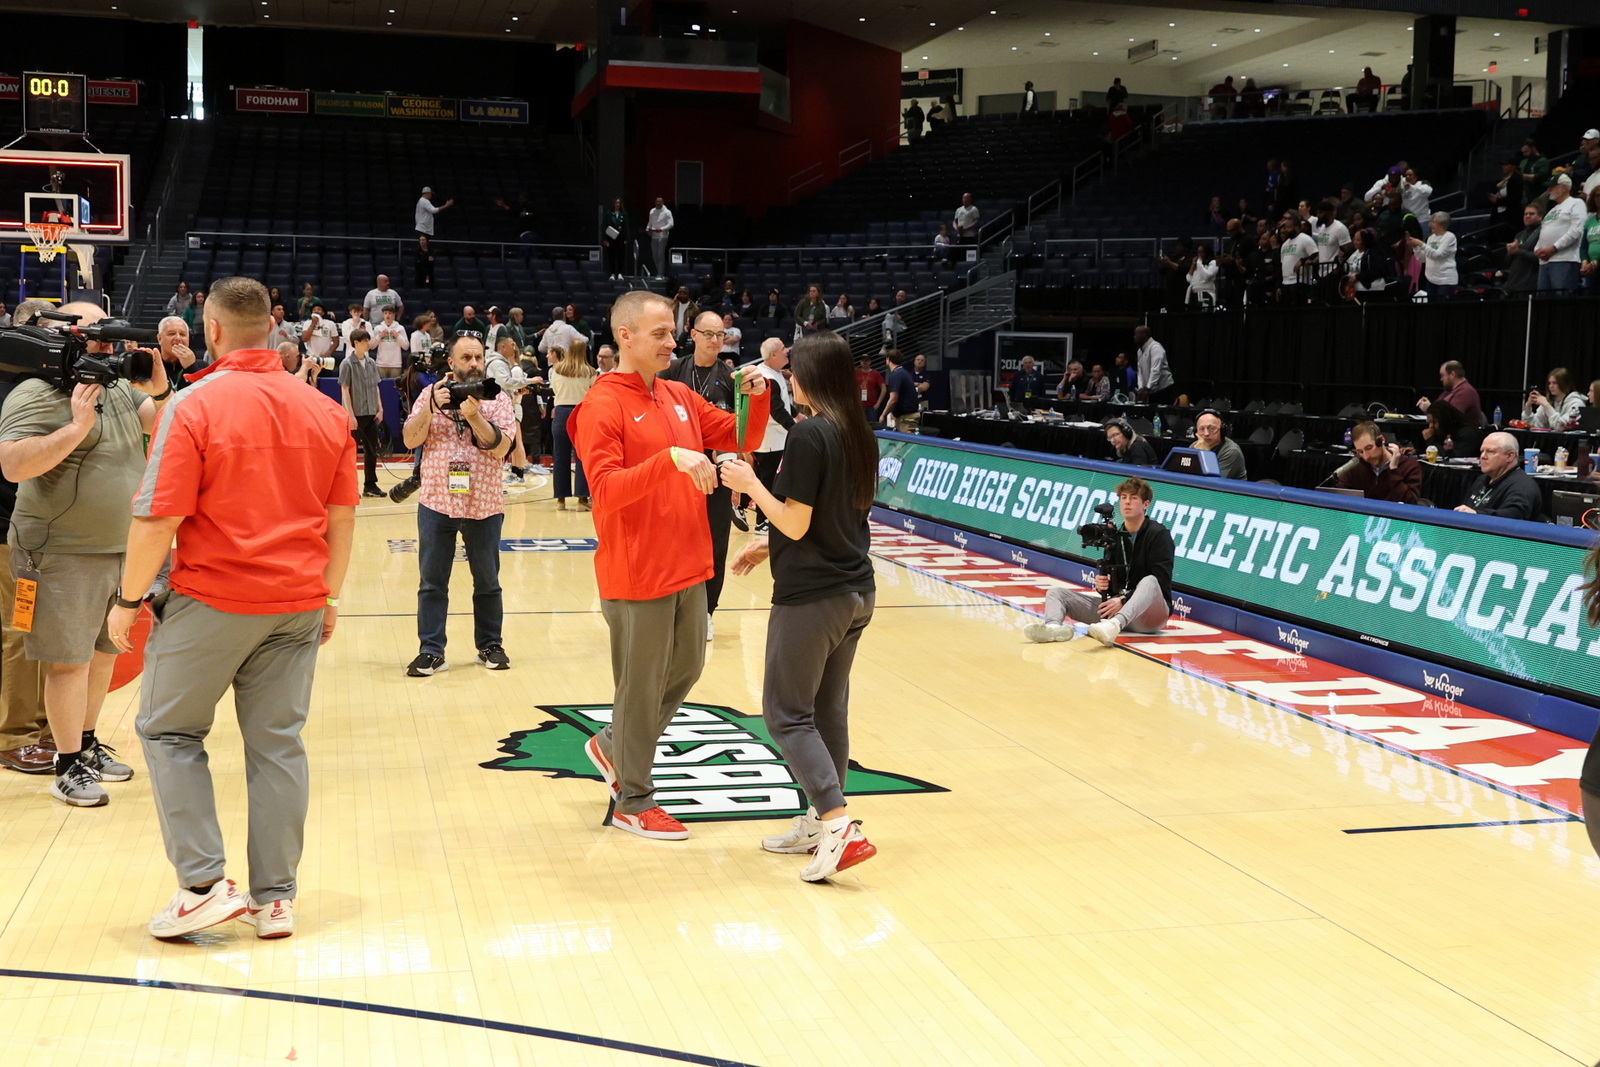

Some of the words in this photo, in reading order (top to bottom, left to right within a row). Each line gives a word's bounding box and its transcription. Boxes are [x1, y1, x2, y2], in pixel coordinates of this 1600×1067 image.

[0, 83, 20, 93] DAY
[246, 95, 299, 106] FORDHAM
[316, 98, 350, 107] GEORGE
[353, 100, 384, 109] MASON
[401, 98, 442, 109] GEORGE
[390, 106, 454, 118] WASHINGTON
[469, 105, 485, 116] LA
[487, 106, 520, 118] SALLE
[906, 457, 959, 501] OHIO
[952, 466, 1018, 515] HIGH
[1150, 499, 1321, 586] THLETIC
[1316, 534, 1600, 658] ASSOCIA
[1173, 597, 1192, 618] Kroger
[1287, 629, 1309, 653] Kroger
[1359, 634, 1389, 647] DAKTRONICS
[1434, 673, 1465, 701] Kroger
